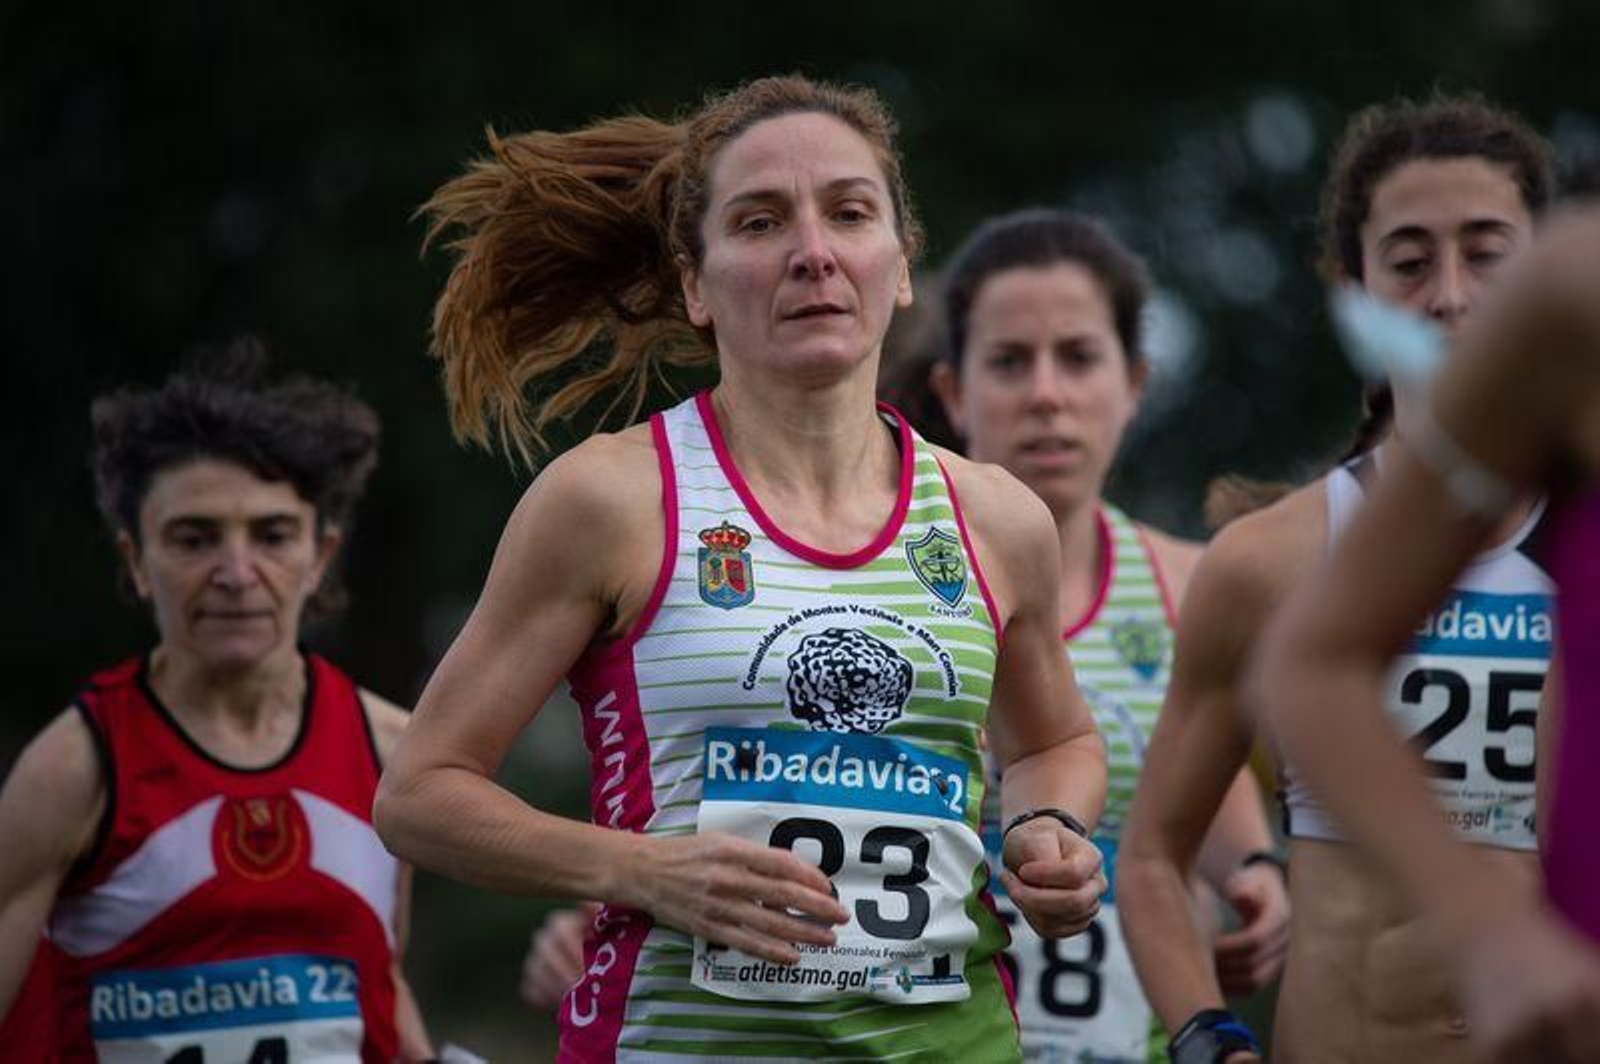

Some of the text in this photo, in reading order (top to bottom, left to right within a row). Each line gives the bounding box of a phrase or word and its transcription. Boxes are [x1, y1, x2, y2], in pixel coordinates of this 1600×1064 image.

[742, 623, 789, 690] Comunidade
[787, 613, 802, 626] de
[802, 604, 848, 620] Montes
[849, 604, 904, 626] Veciñais
[915, 628, 941, 653] Man
[1401, 667, 1544, 782] 25
[706, 740, 931, 795] Ribadavia
[91, 964, 355, 1022] Ribadavia 22
[737, 959, 869, 991] atletismo.gal
[994, 909, 1106, 1019] 8
